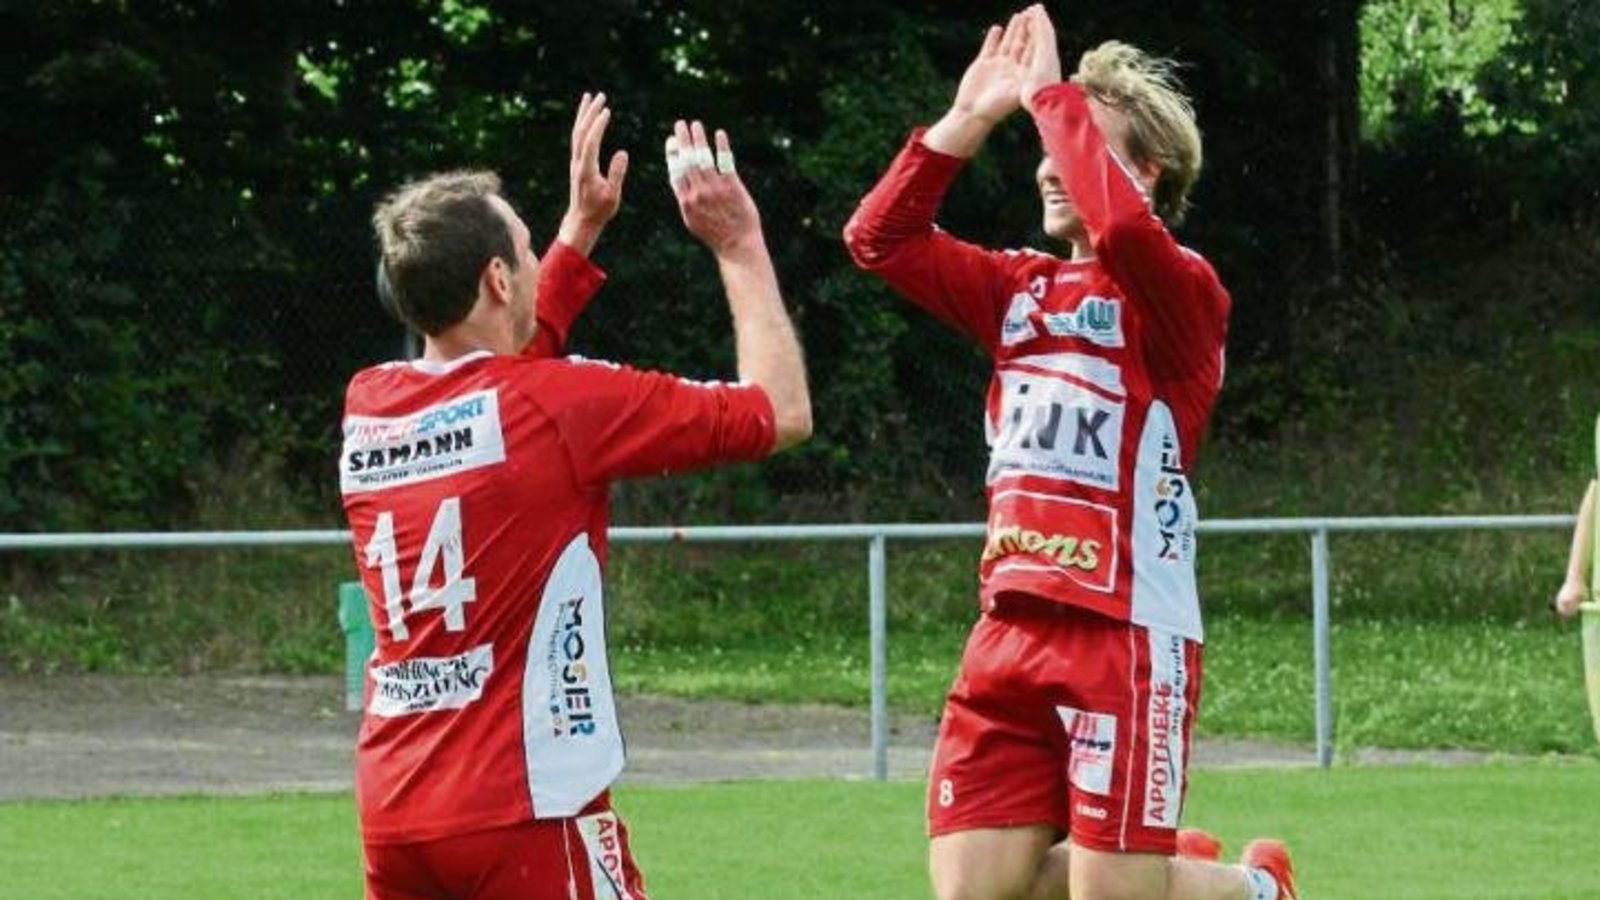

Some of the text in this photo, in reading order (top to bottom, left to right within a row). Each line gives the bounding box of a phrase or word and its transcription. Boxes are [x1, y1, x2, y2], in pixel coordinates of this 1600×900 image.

[363, 497, 477, 642] 14
[562, 597, 596, 736] MOSER
[938, 779, 955, 807] 8
[1148, 681, 1172, 823] APOTHEKE
